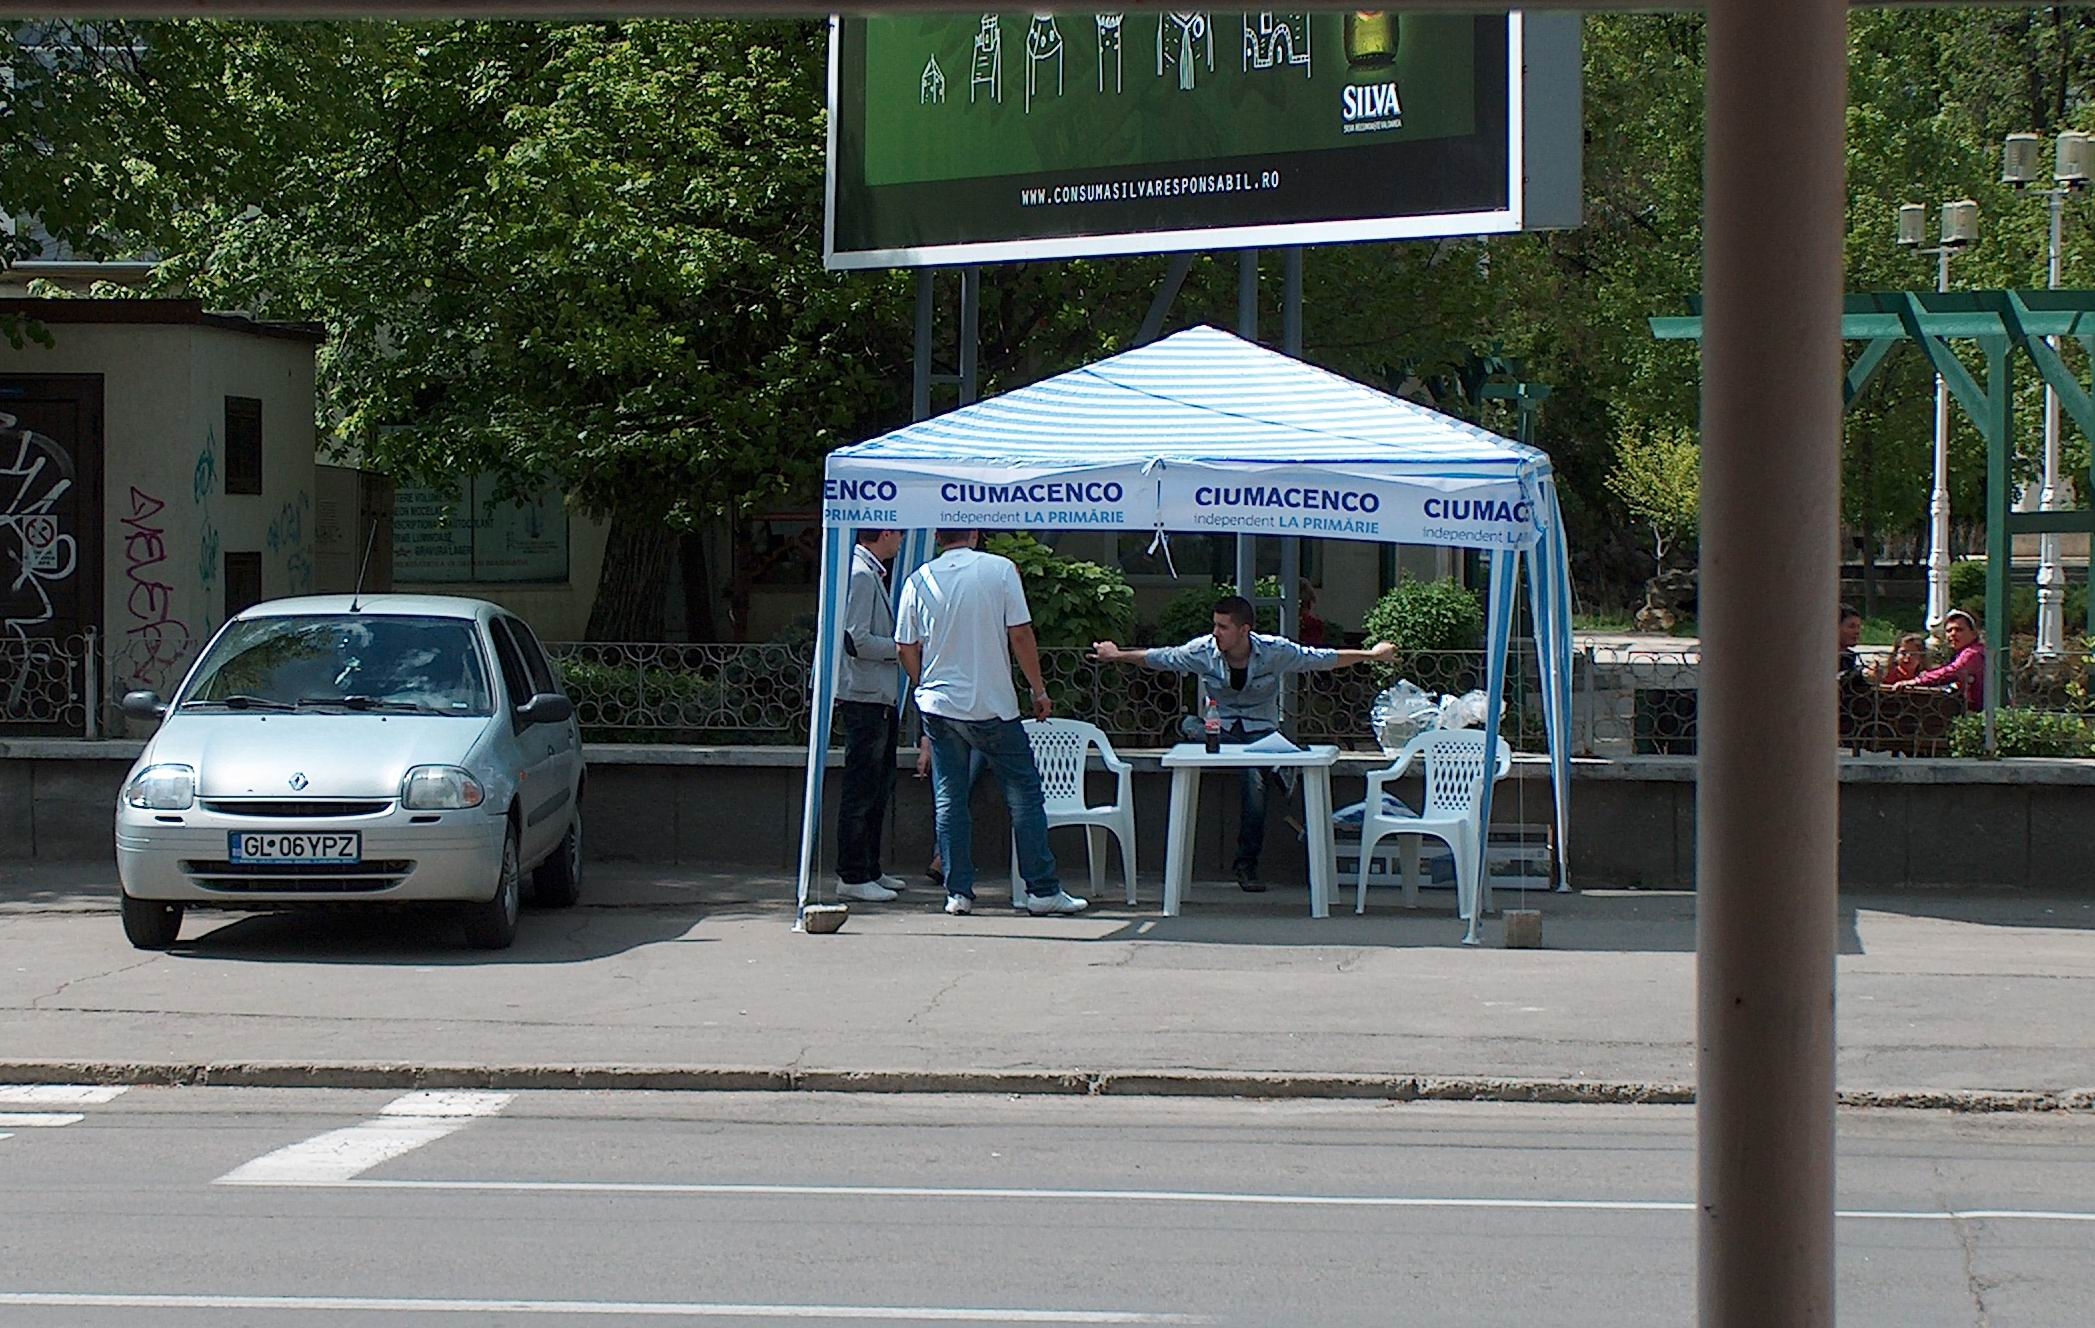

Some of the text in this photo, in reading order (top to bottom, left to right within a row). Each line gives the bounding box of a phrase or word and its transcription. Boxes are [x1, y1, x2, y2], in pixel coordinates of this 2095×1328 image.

[1343, 83, 1401, 121] SILVA
[1021, 171, 1279, 205] WWW.CONSUMASILVARESPONSABIL.RO
[824, 480, 897, 501] ENCO
[941, 482, 1123, 503] CIUMACENCO
[1195, 486, 1380, 513] CIUMACENCO
[940, 509, 1124, 525] independent LA PRIMĂRIE
[1194, 513, 1379, 534] independent LA PRIMĂRIE
[1423, 526, 1503, 543] independent
[244, 836, 272, 857] GL
[306, 836, 354, 857] YPZ
